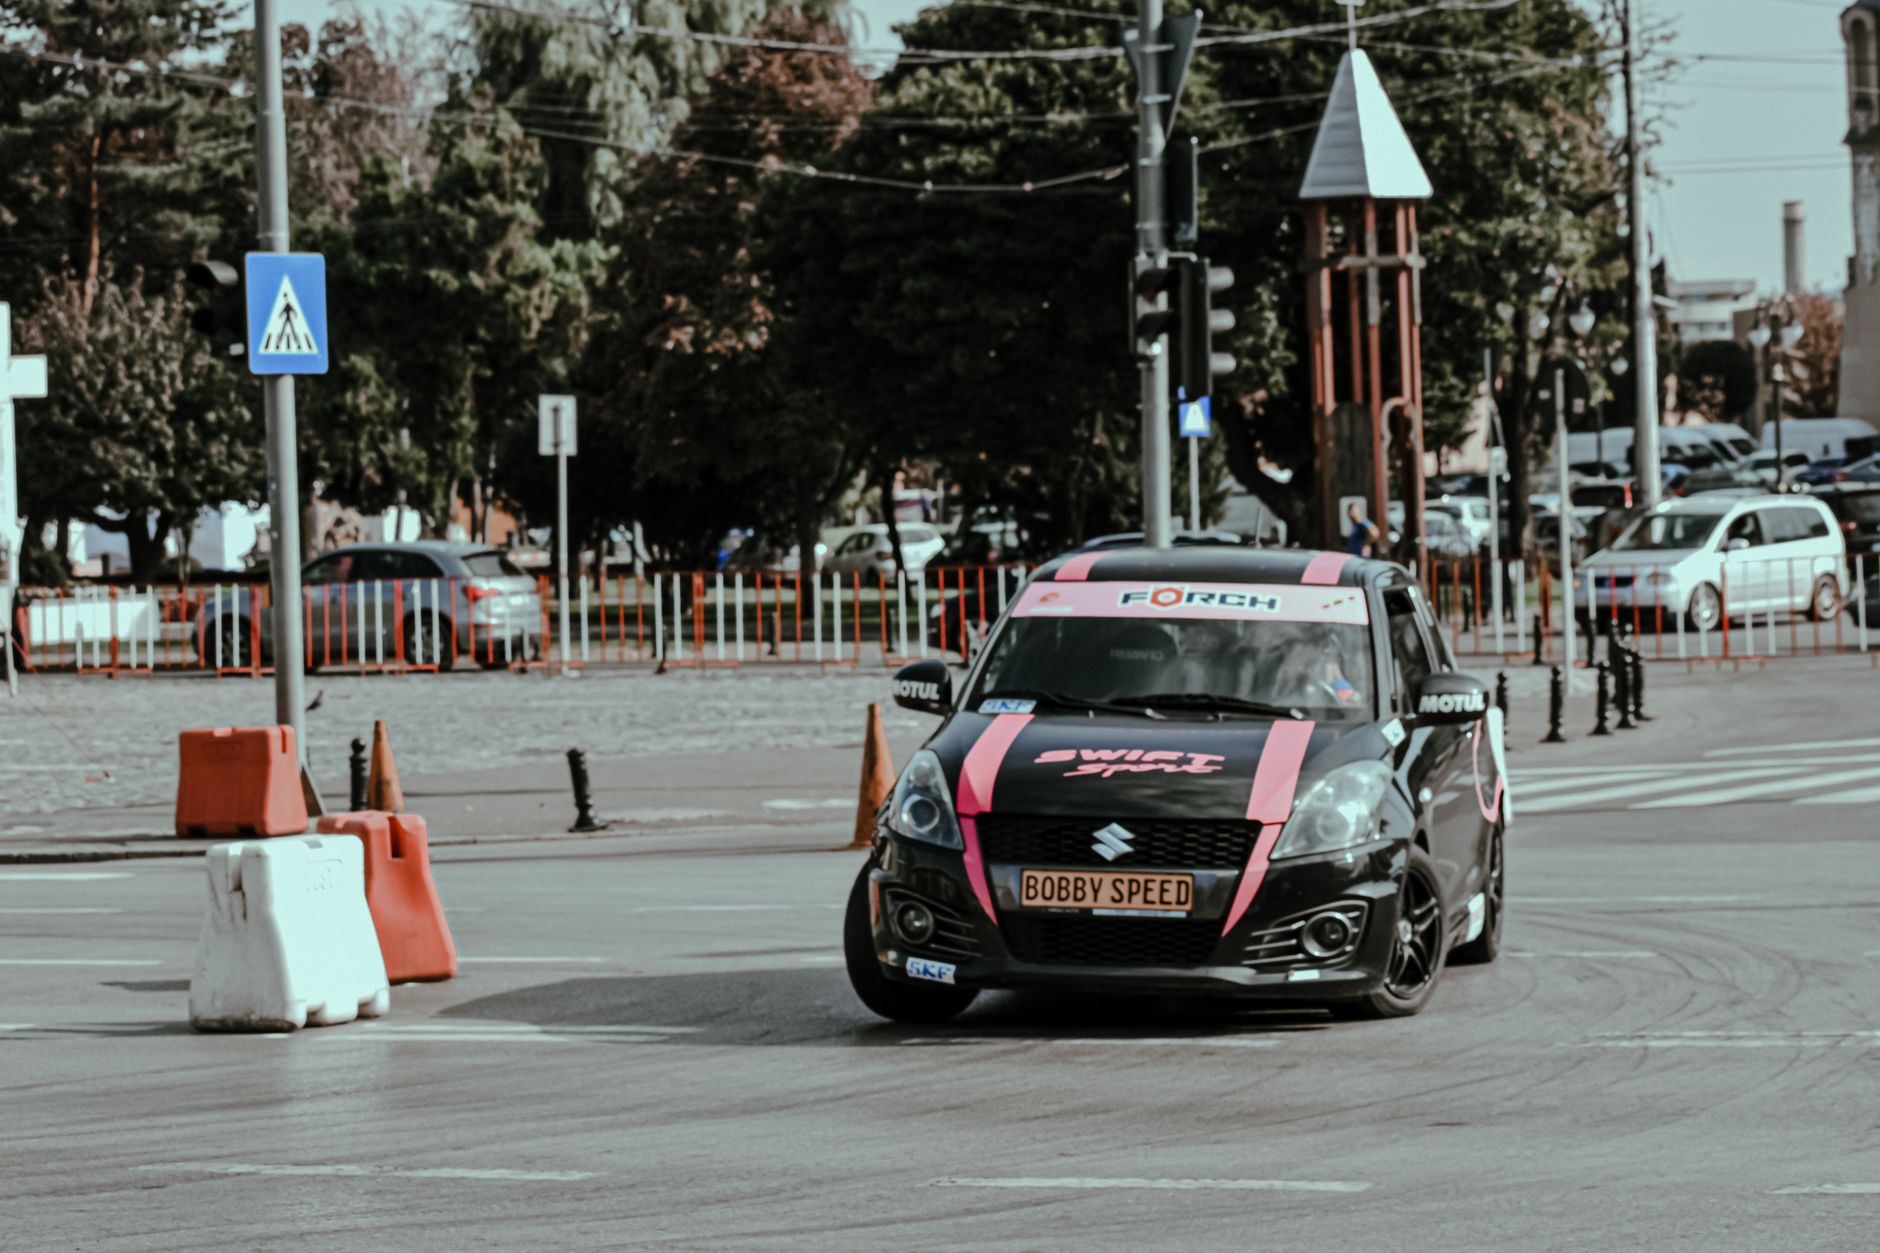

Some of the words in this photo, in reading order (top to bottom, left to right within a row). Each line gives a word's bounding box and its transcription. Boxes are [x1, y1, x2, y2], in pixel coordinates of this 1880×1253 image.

[1419, 693, 1485, 713] MOTUL
[1033, 749, 1226, 769] SWIFT
[1025, 875, 1103, 903] BOBBY
[1110, 878, 1190, 906] SPEED
